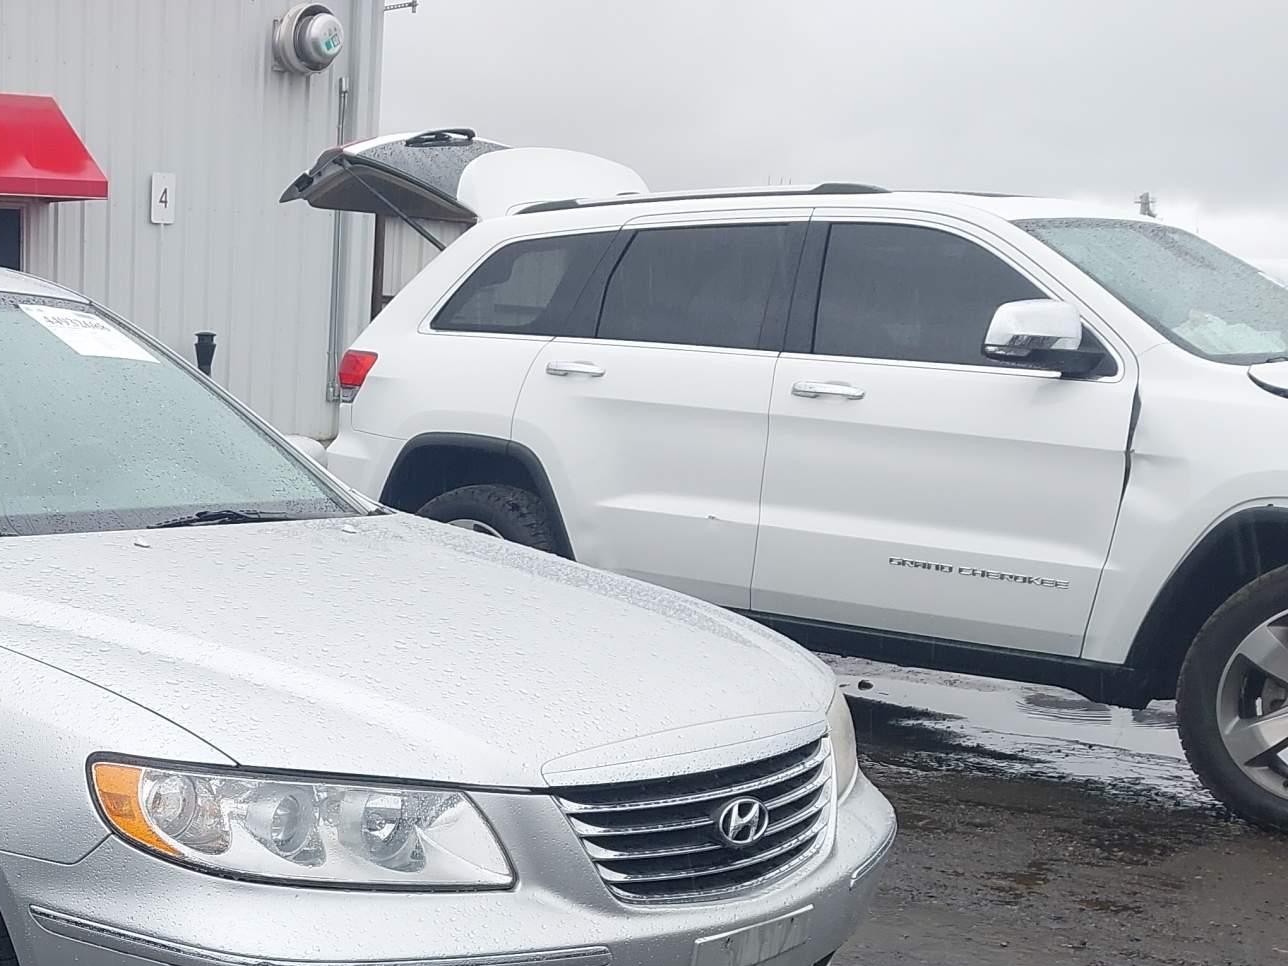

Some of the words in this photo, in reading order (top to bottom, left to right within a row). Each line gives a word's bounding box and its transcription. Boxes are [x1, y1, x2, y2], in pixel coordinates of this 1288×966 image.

[158, 187, 168, 209] 4
[888, 556, 953, 573] GRAND
[958, 566, 1071, 590] CHEROKEE
